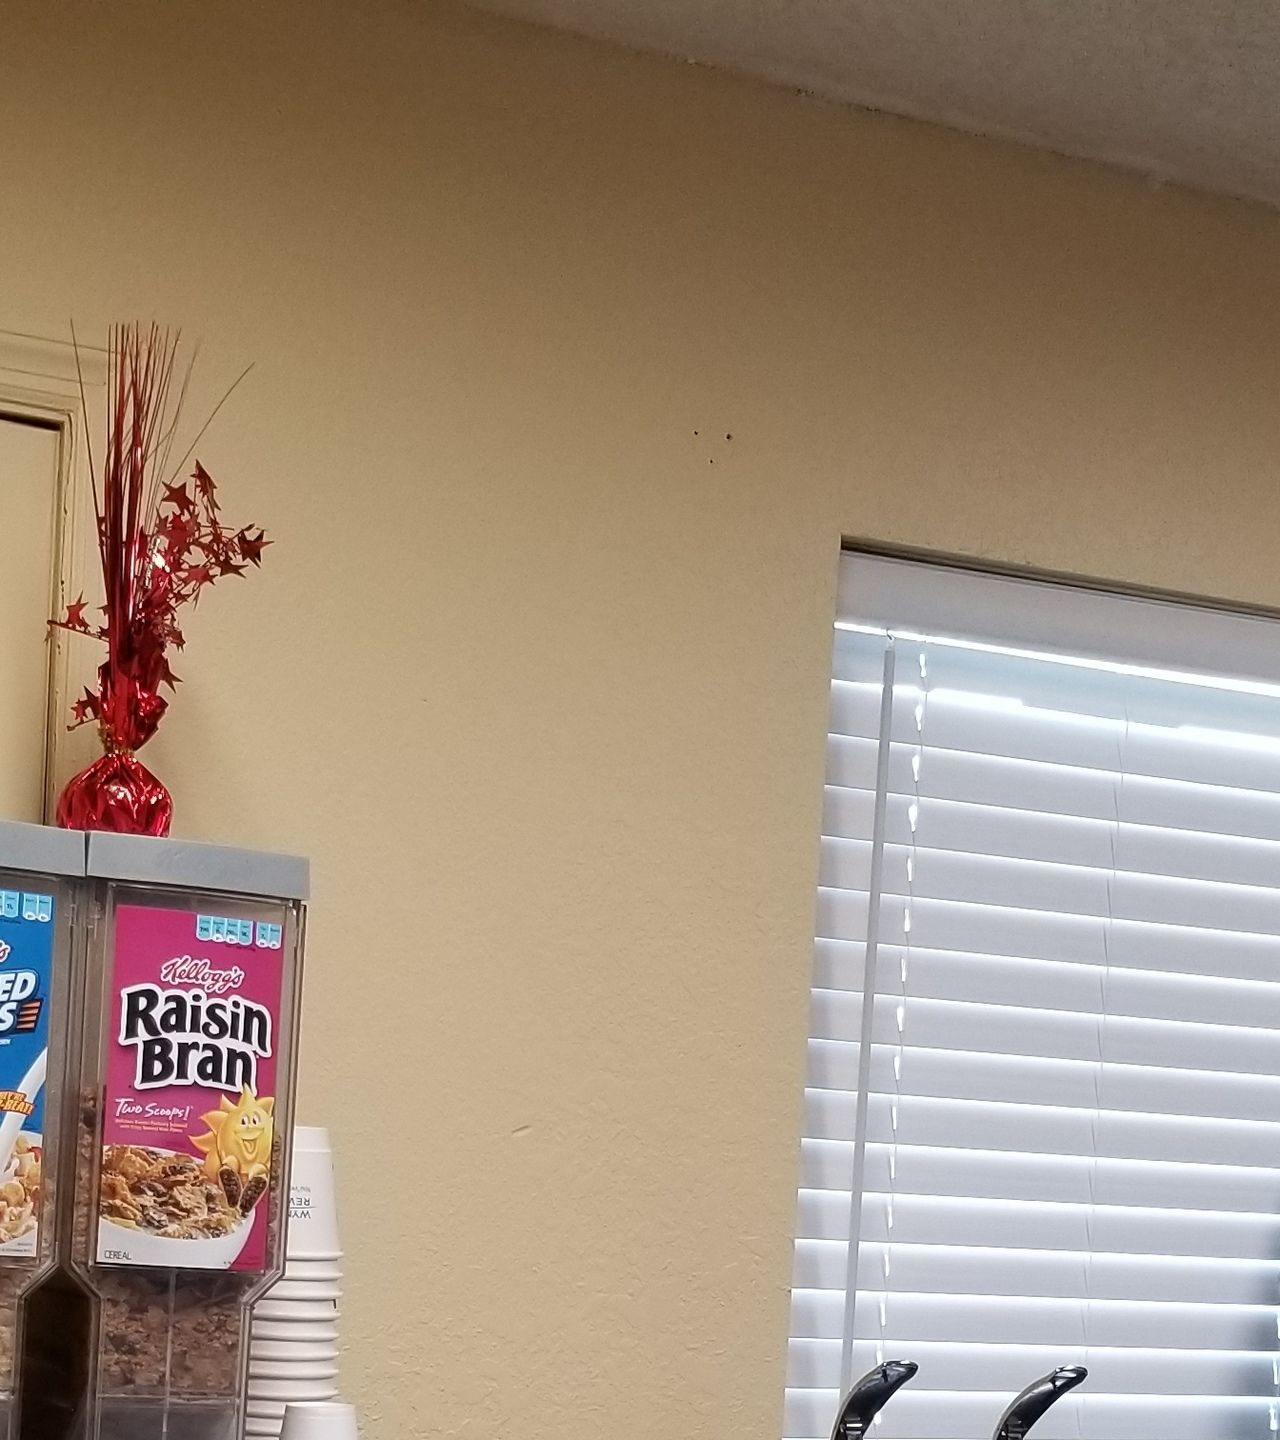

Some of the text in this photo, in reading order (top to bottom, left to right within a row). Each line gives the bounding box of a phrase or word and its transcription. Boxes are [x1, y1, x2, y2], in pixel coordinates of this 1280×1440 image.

[161, 956, 245, 993] Kellogg's
[124, 988, 268, 1053] Raisin
[140, 1037, 252, 1090] Bran
[115, 1098, 191, 1121] Two Scoops!
[104, 1250, 132, 1260] CEREAL
